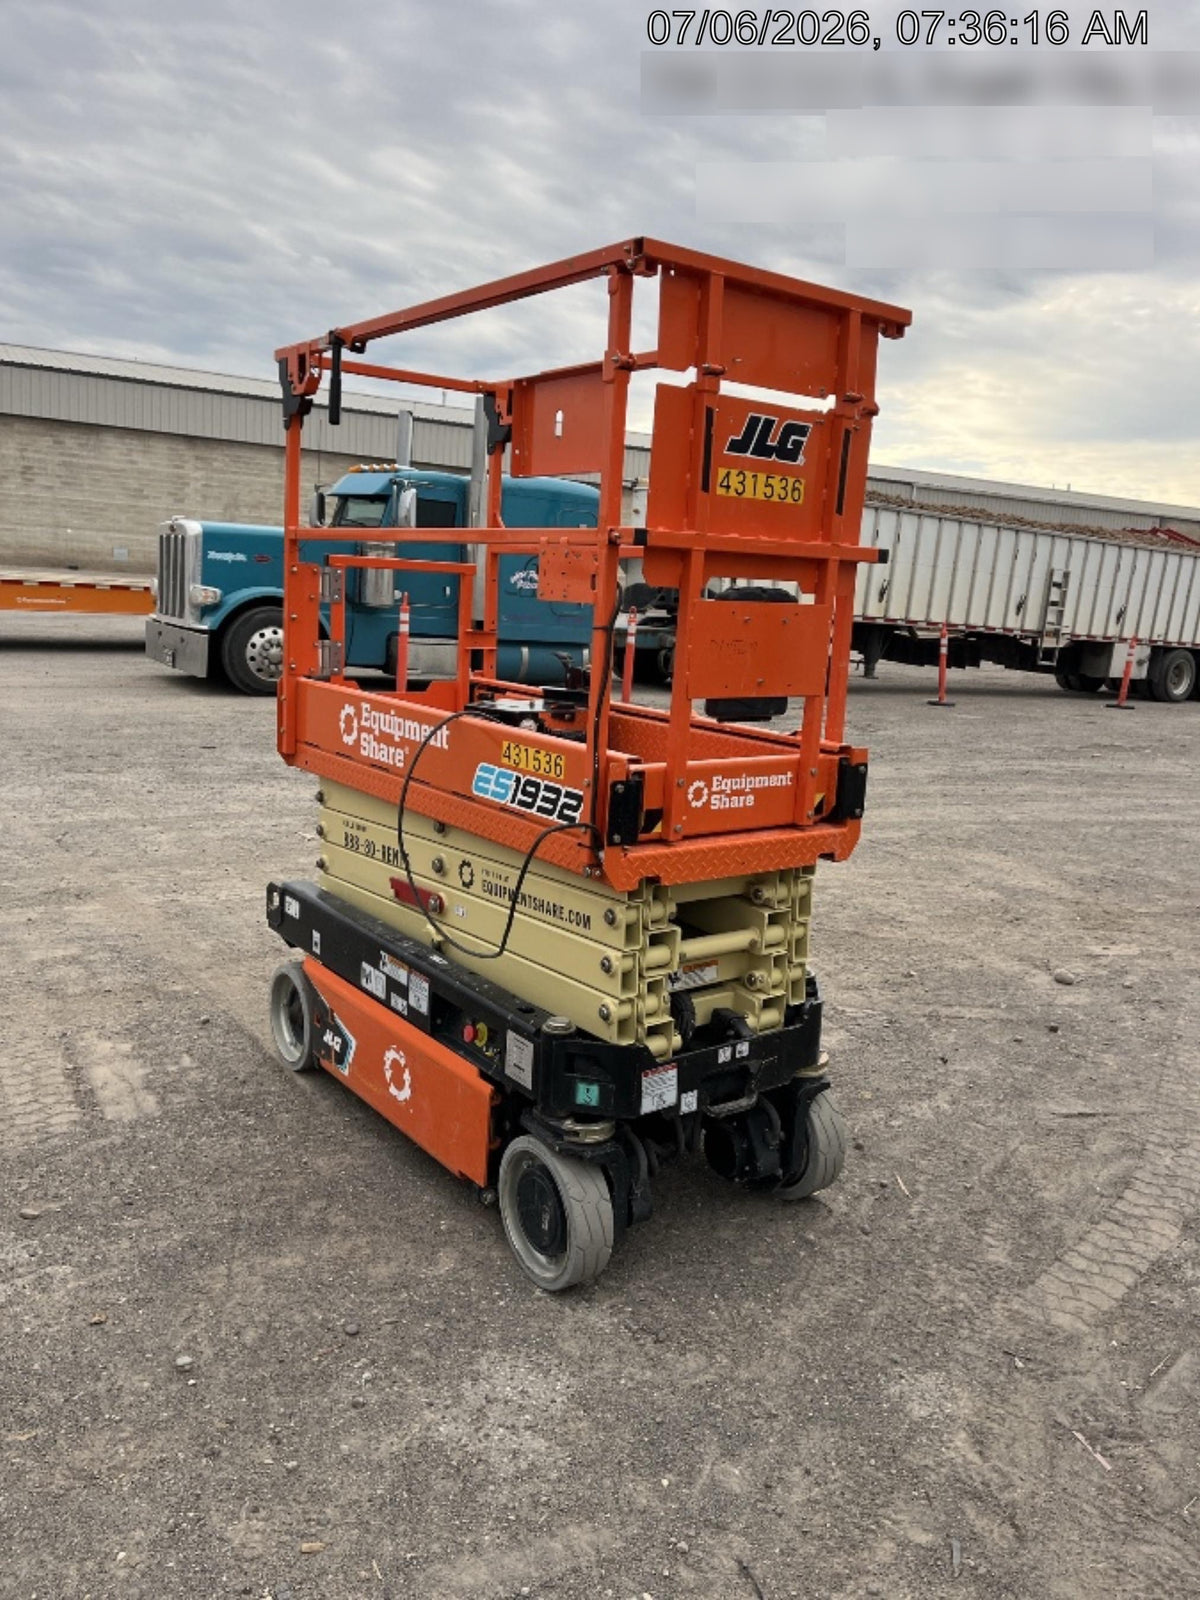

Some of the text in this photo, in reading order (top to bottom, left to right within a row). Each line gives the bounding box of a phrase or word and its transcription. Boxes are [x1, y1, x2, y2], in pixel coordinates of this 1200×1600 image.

[724, 412, 813, 465] JLG
[718, 469, 803, 503] 431536
[360, 702, 450, 750] Equipment
[502, 742, 564, 778] 431536
[472, 762, 584, 825] ES1932
[711, 771, 793, 793] Equipment
[710, 794, 754, 810] Share
